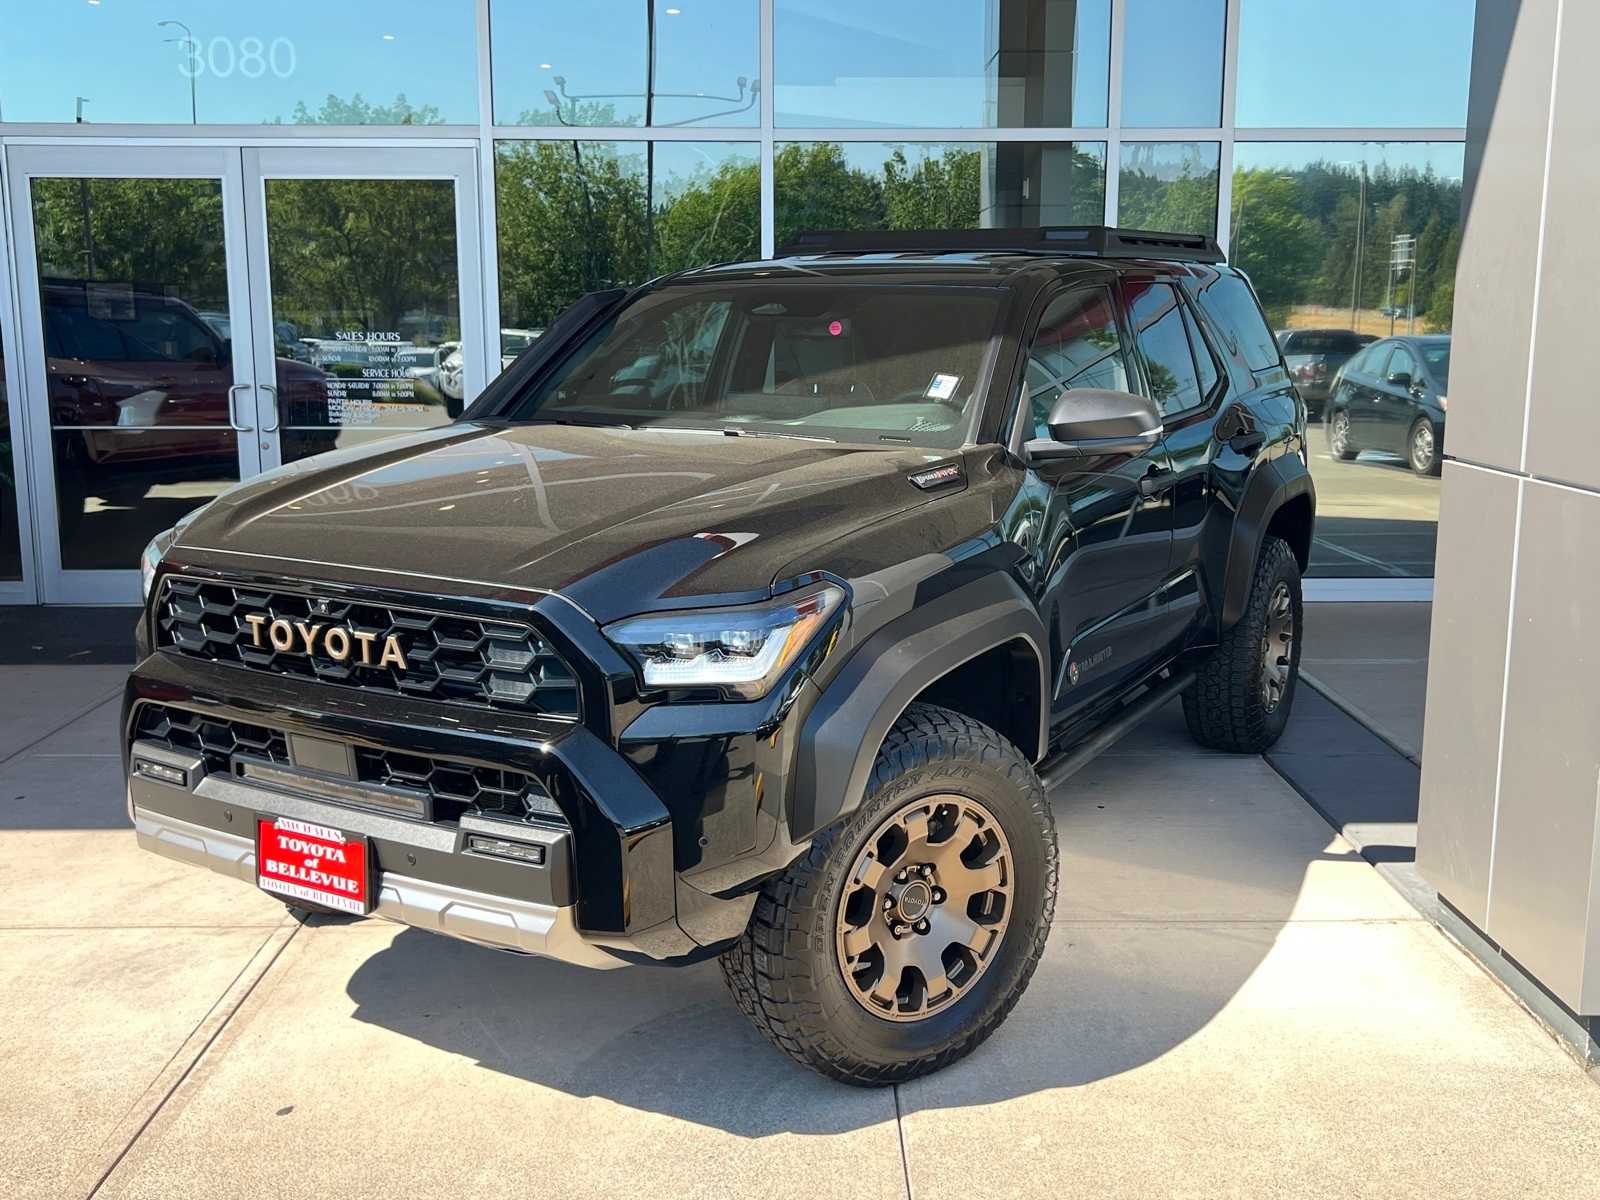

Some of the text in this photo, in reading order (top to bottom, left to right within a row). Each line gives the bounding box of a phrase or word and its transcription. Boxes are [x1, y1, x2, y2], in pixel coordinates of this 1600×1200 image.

[177, 36, 297, 78] 3080
[335, 331, 401, 341] SALES HOURS
[361, 367, 389, 378] SERVICE
[245, 613, 407, 670] TOYOTA
[277, 834, 346, 863] TOYOTA
[265, 859, 359, 893] BELLEVUE
[303, 858, 319, 869] of
